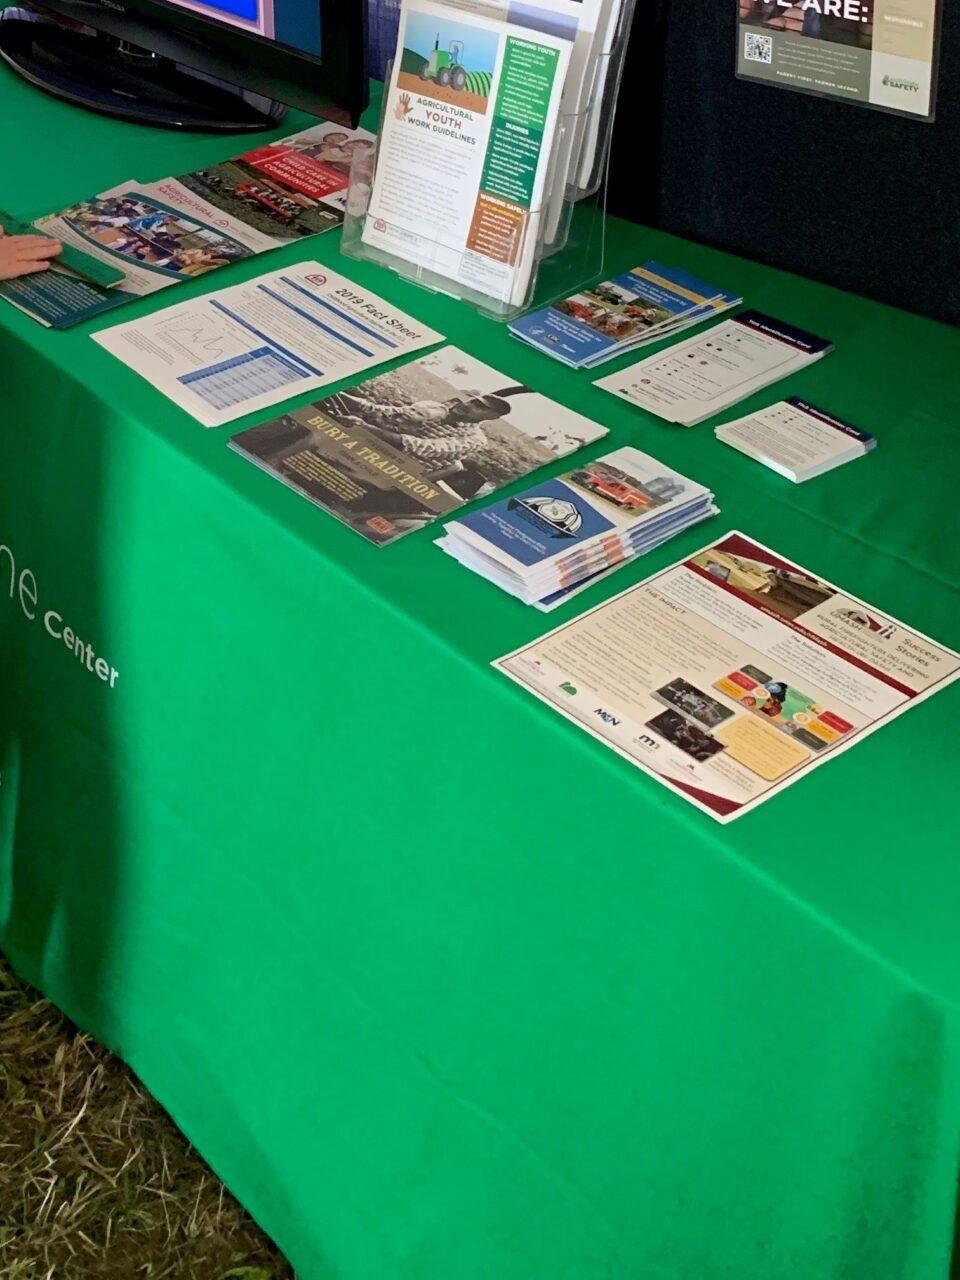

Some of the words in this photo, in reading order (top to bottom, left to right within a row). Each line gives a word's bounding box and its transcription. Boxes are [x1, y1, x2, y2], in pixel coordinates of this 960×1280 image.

[417, 97, 474, 121] AGRICULTURAL
[426, 110, 462, 129] YOUTH
[408, 116, 430, 130] WORK
[433, 124, 476, 145] GUIDELINES
[264, 163, 320, 193] COMMUNITIES
[272, 161, 330, 191] AGRICULTURAL
[282, 157, 306, 171] CHILD
[306, 169, 327, 181] CARE
[164, 184, 215, 218] AGRICULTURAL
[335, 288, 365, 305] 2019
[360, 303, 389, 320] Fact
[385, 318, 422, 340] Sheet
[307, 415, 350, 441] BURY
[343, 440, 358, 450] A
[356, 446, 440, 500] TRADITION
[830, 611, 863, 631] UMASH
[44, 610, 119, 688] Center
[896, 645, 929, 667] Stories
[902, 638, 942, 662] Success
